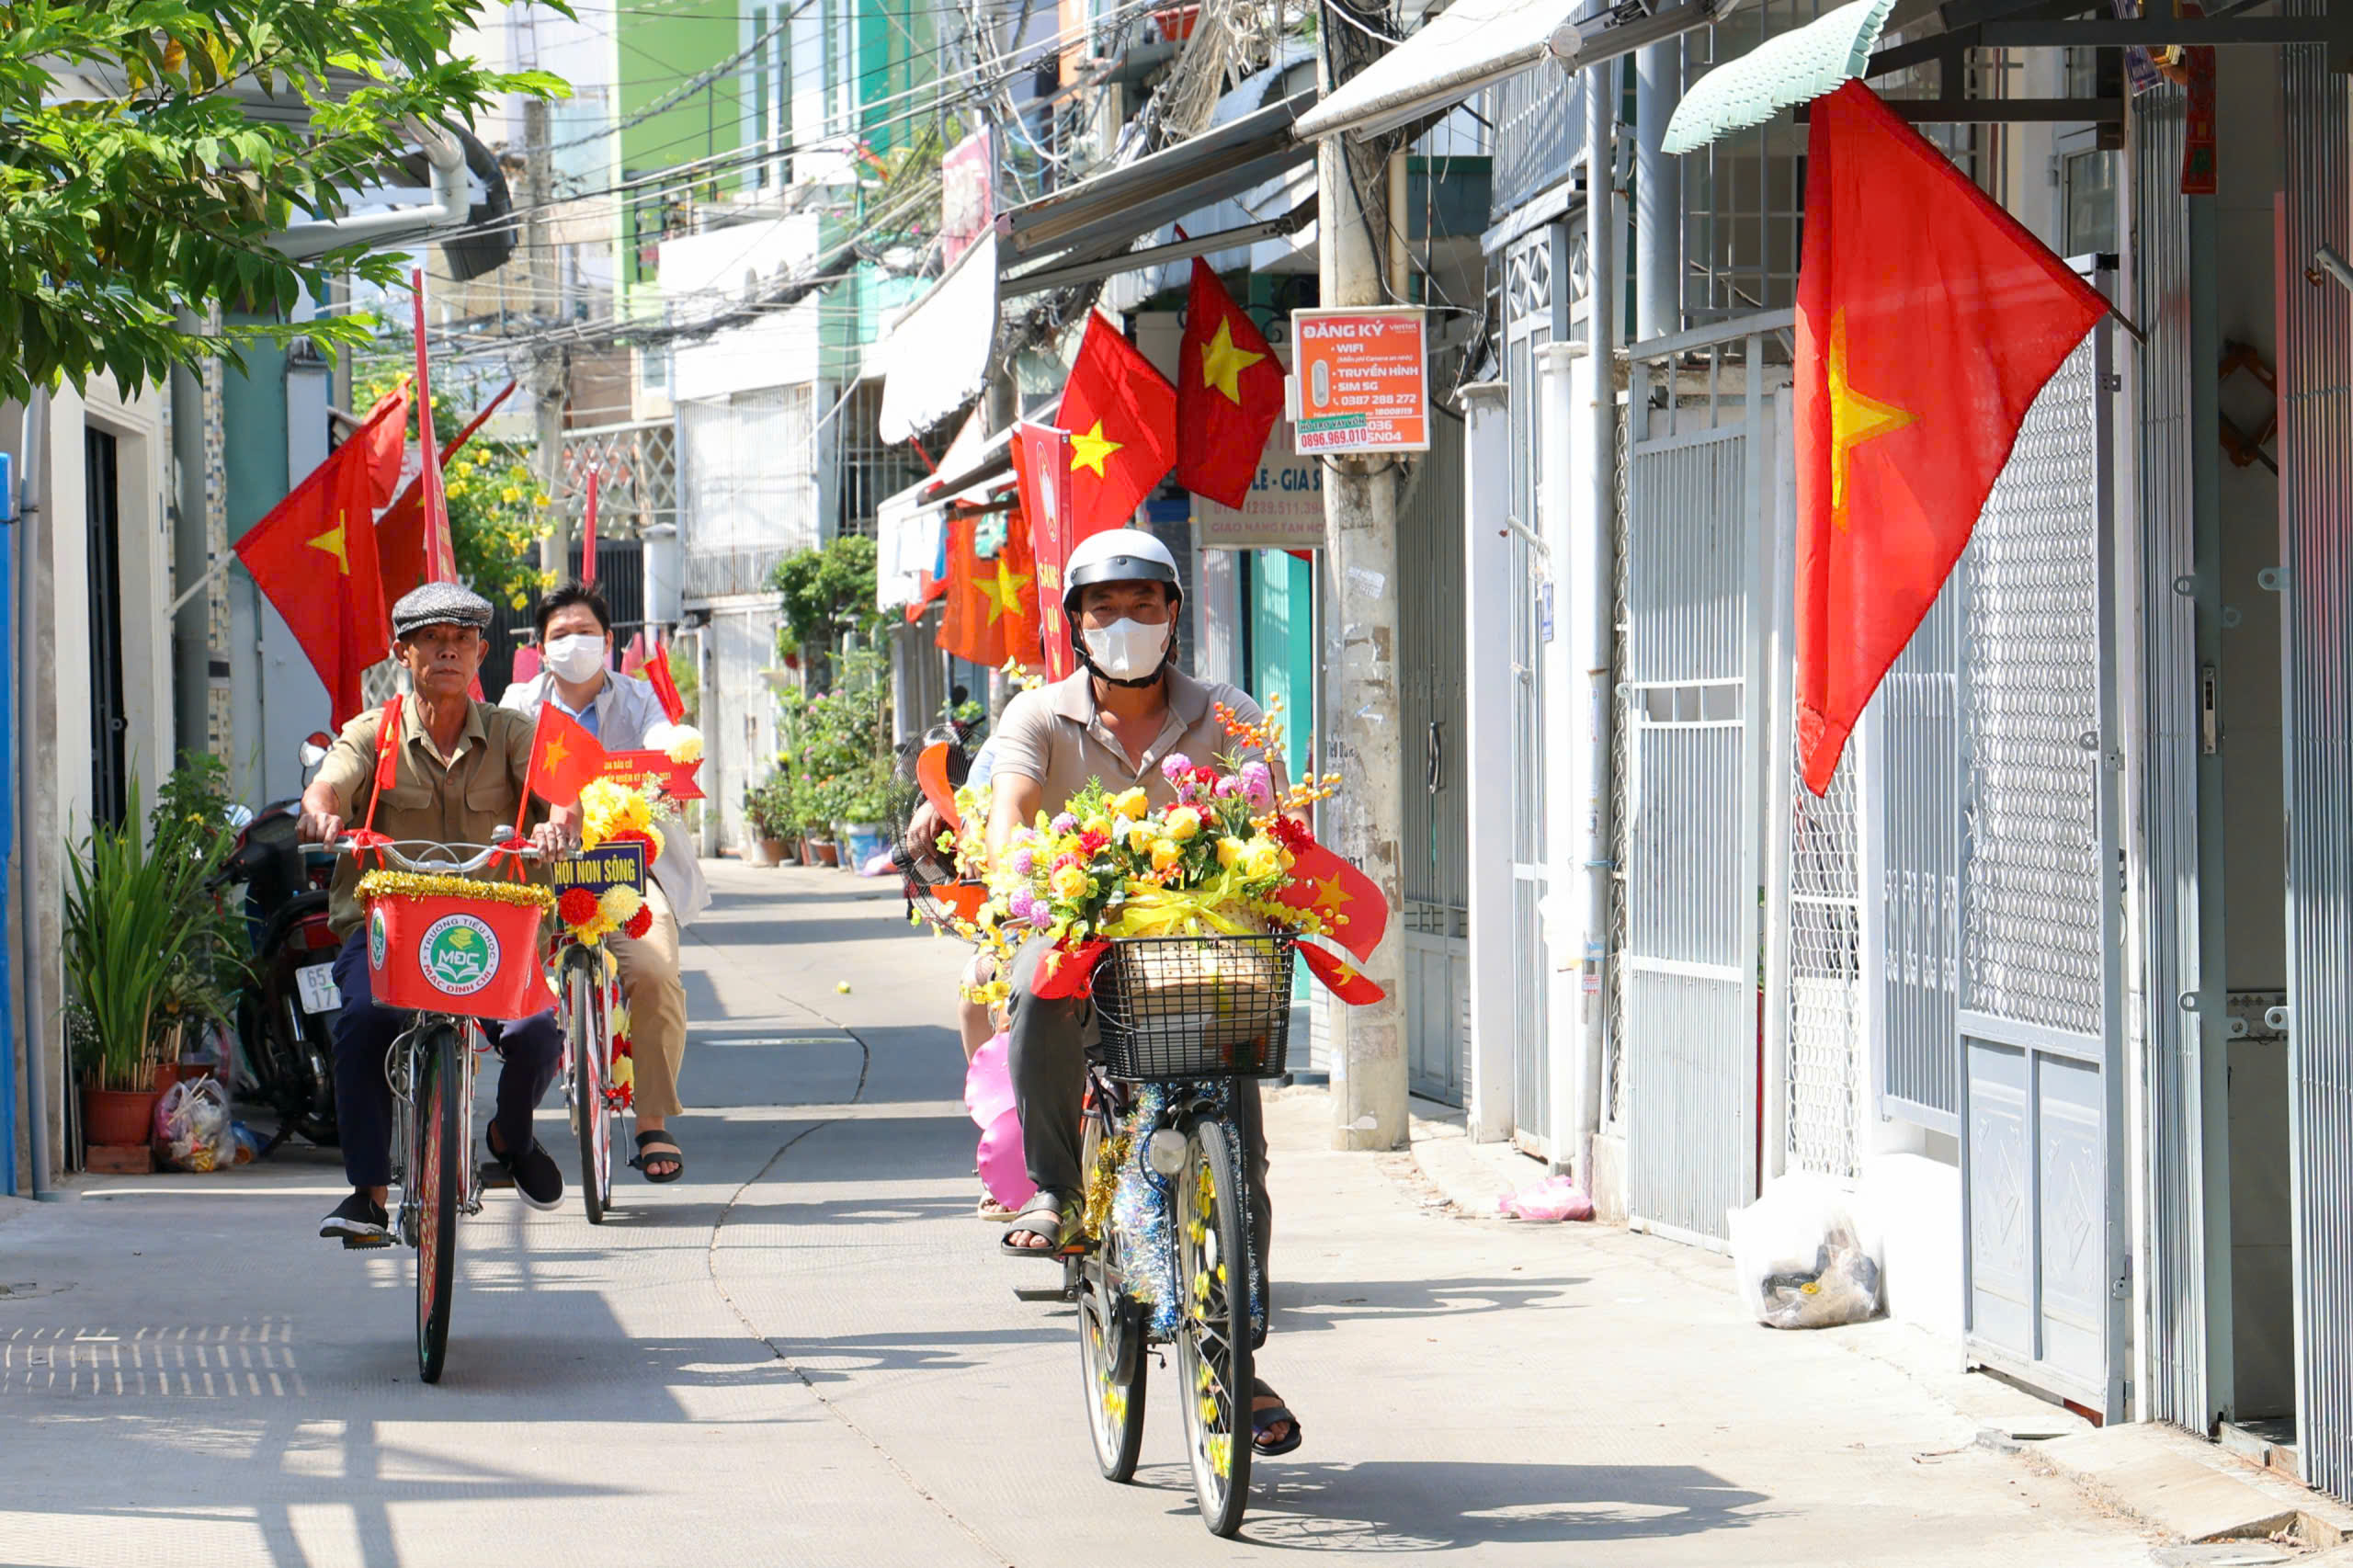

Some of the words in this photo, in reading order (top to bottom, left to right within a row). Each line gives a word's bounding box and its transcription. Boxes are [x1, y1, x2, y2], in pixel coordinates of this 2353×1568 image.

[1302, 322, 1356, 338] ĐĂNG
[1358, 320, 1384, 337] KÝ
[1337, 344, 1364, 353] WIFI
[1338, 364, 1386, 378] TRUYỀN
[1389, 363, 1418, 376] HÌNH
[1338, 382, 1360, 392] SIM
[1341, 394, 1370, 405] 0387
[1371, 394, 1393, 404] 288
[1396, 393, 1416, 403] 272
[1332, 419, 1347, 428] VAY
[1302, 427, 1367, 448] 0896.969.010
[554, 857, 574, 890] HỘI
[576, 859, 601, 884] NON
[604, 854, 635, 883] SÔNG
[424, 918, 459, 951] TRƯỜNG
[462, 918, 486, 935] TIỂU
[484, 934, 496, 960] HỌC
[436, 949, 480, 966] MĐC
[475, 970, 492, 987] CHI
